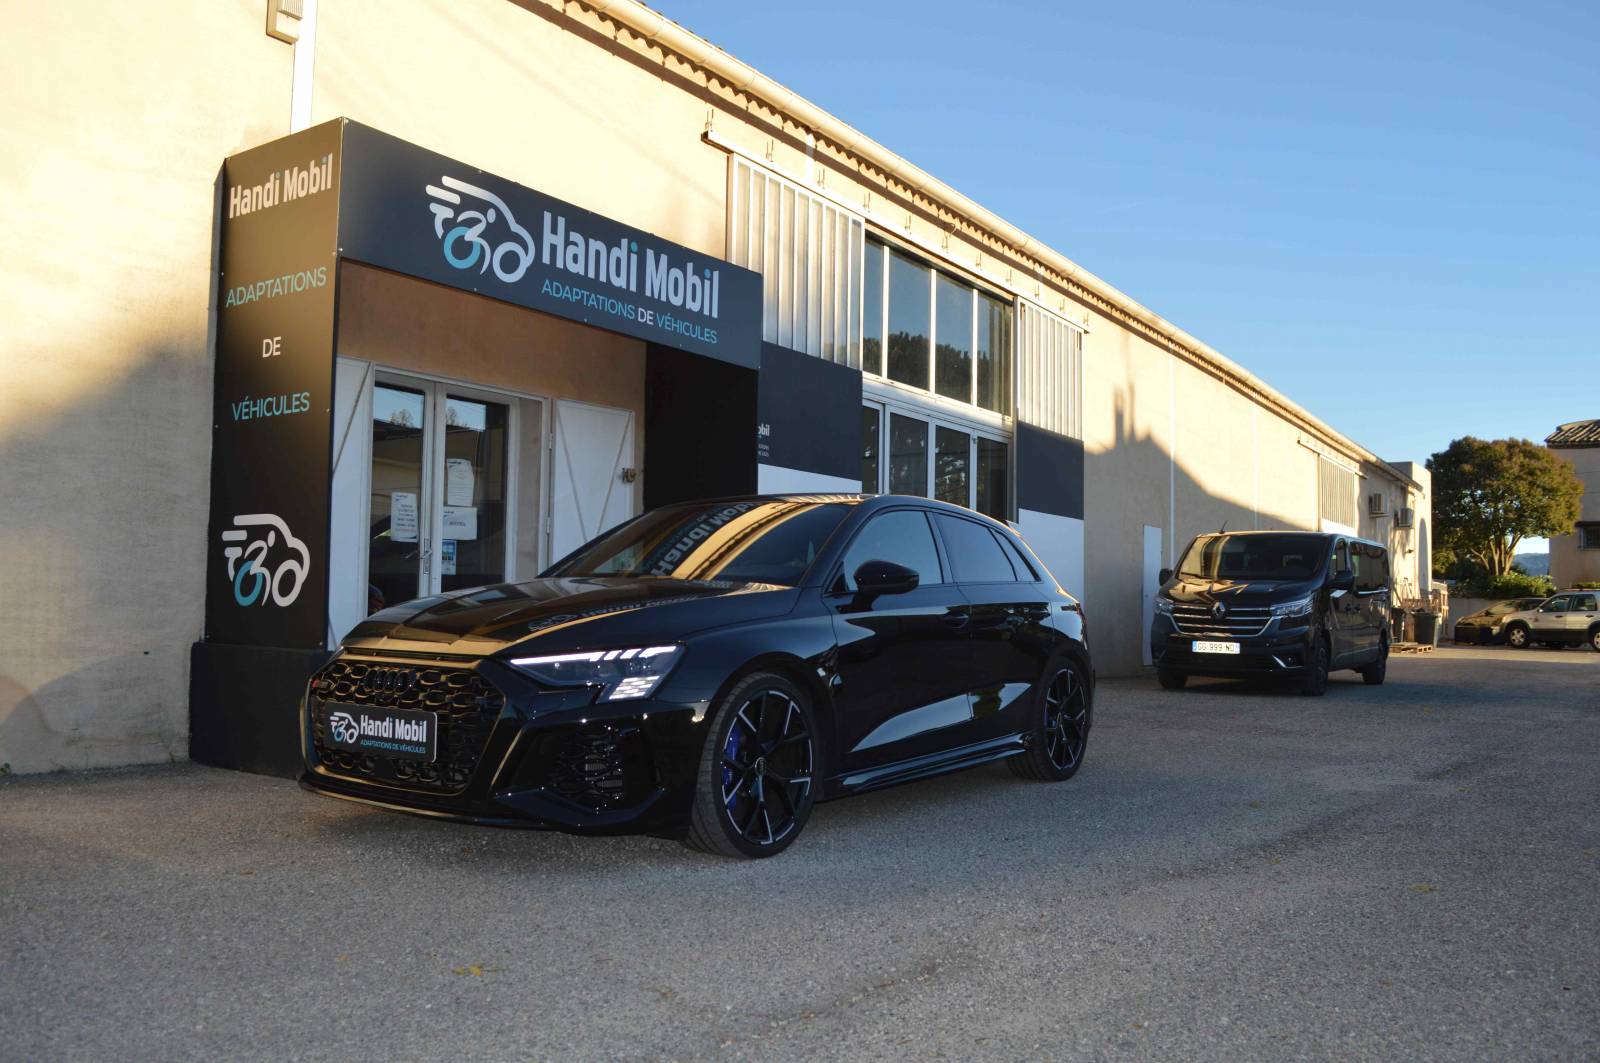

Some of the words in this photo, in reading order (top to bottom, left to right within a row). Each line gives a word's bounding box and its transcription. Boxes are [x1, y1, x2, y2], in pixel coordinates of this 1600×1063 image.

[229, 172, 281, 219] Handi
[283, 153, 333, 203] Mobil
[541, 210, 638, 292] Handi
[645, 248, 719, 319] Mobil
[225, 266, 327, 308] ADAPTATIONS
[541, 279, 635, 320] ADAPTATIONS
[637, 308, 654, 326] DE
[656, 311, 717, 344] VÉHICULES
[262, 336, 282, 358] DE
[231, 391, 310, 421] VÉHICULES
[360, 715, 393, 738] Handi
[395, 720, 427, 742] Mobil
